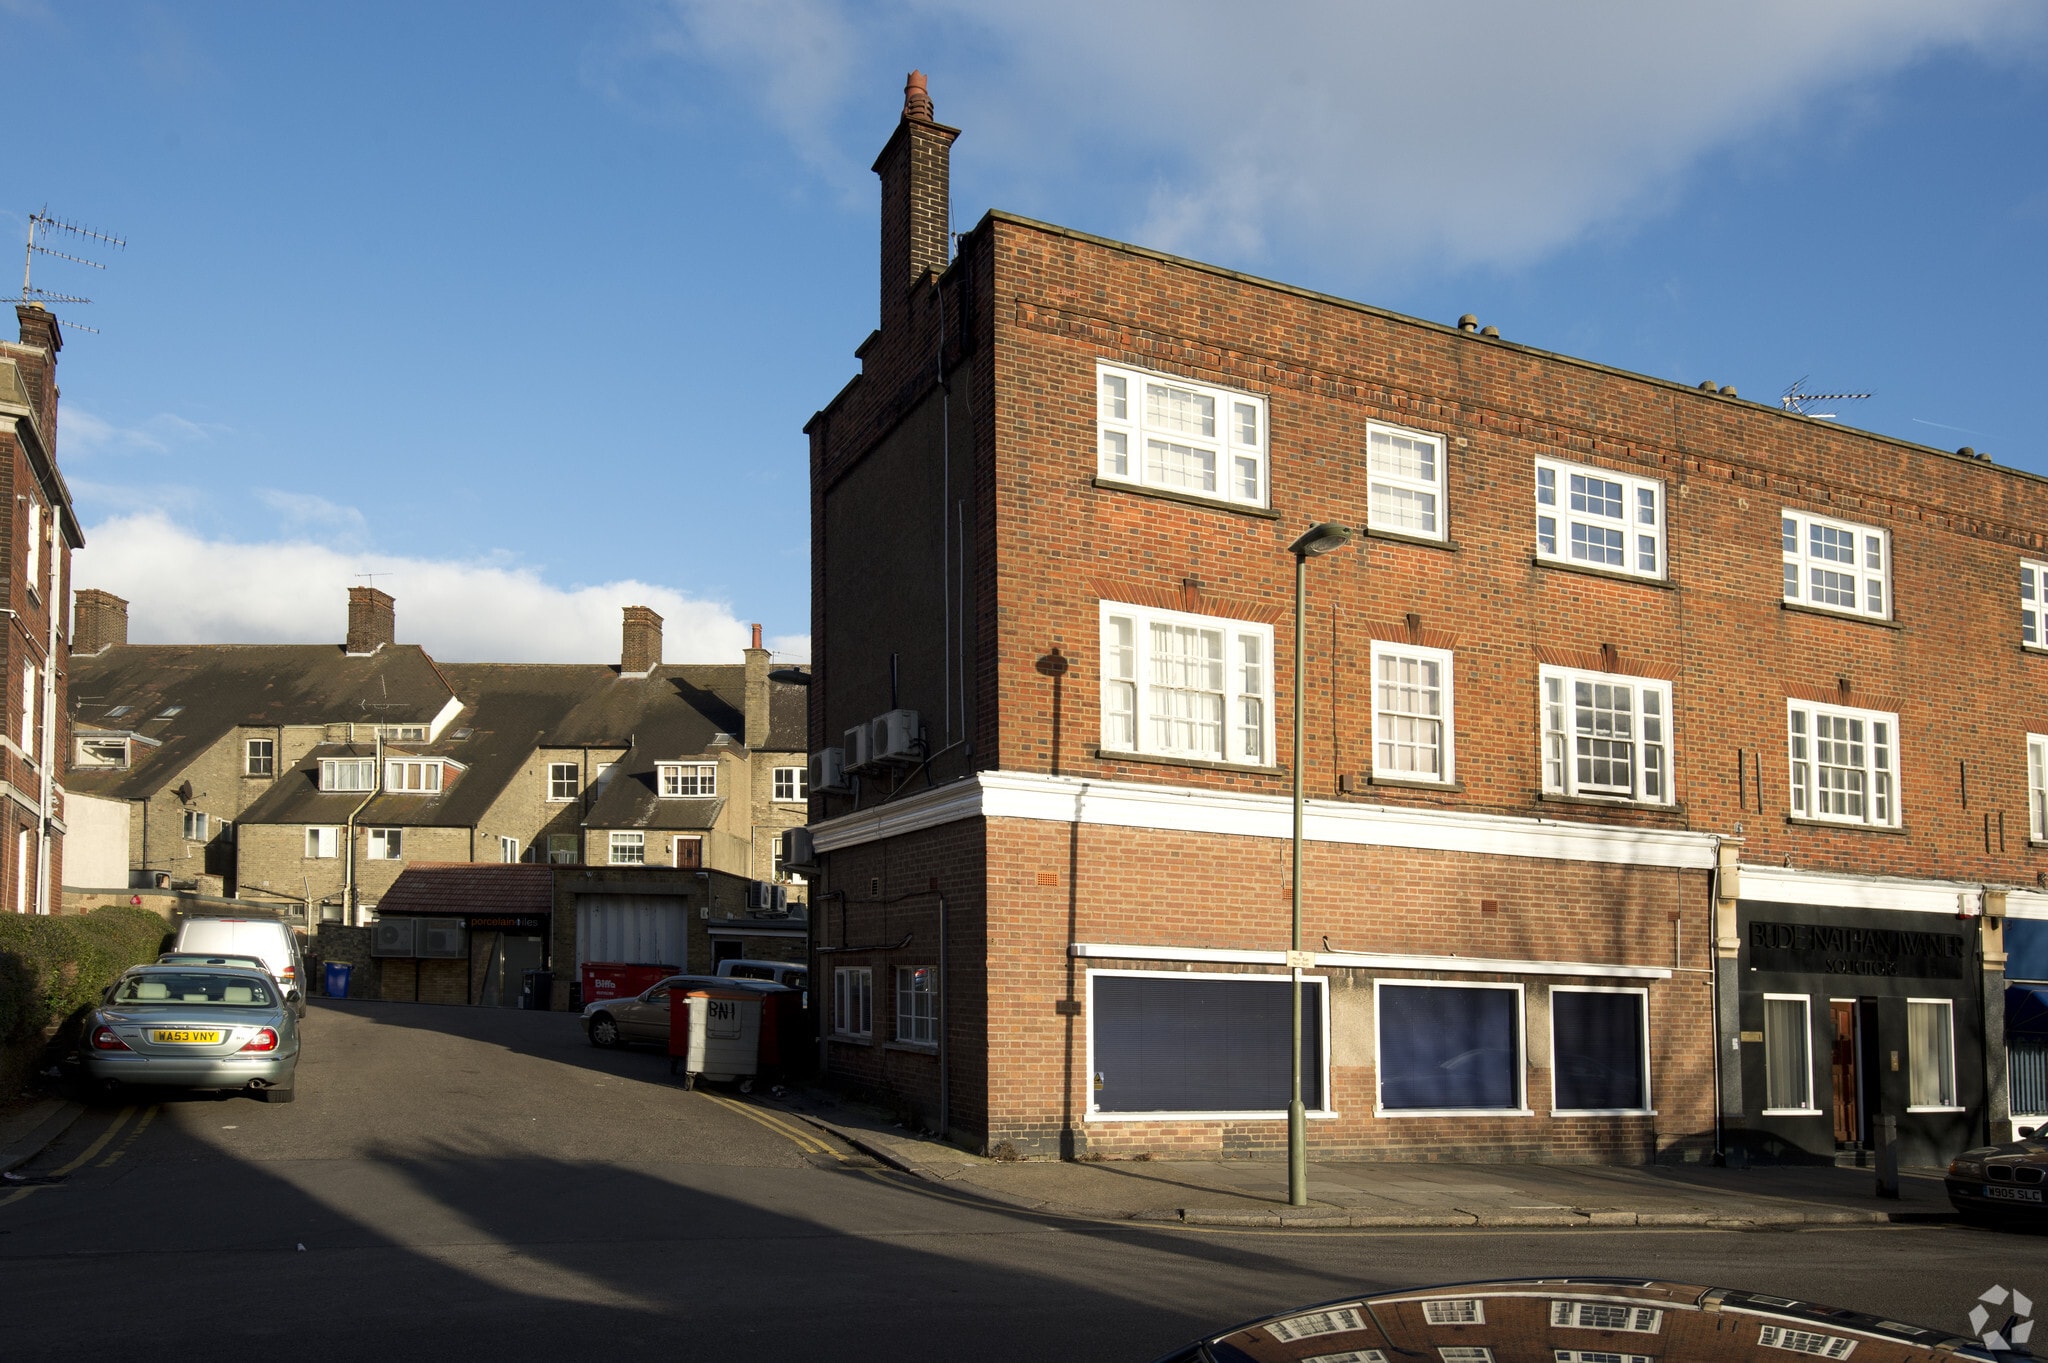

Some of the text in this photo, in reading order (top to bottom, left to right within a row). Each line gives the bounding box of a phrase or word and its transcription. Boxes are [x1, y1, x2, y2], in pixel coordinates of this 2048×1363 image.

[471, 917, 515, 928] porcelain
[1750, 923, 1807, 951] BUDE
[1811, 926, 1891, 956] NATHAN
[1825, 959, 1898, 976] SOLICITORS
[595, 979, 616, 988] Biffa
[159, 1031, 215, 1041] WA53 VNY
[1989, 1186, 2040, 1201] W905 SLC
